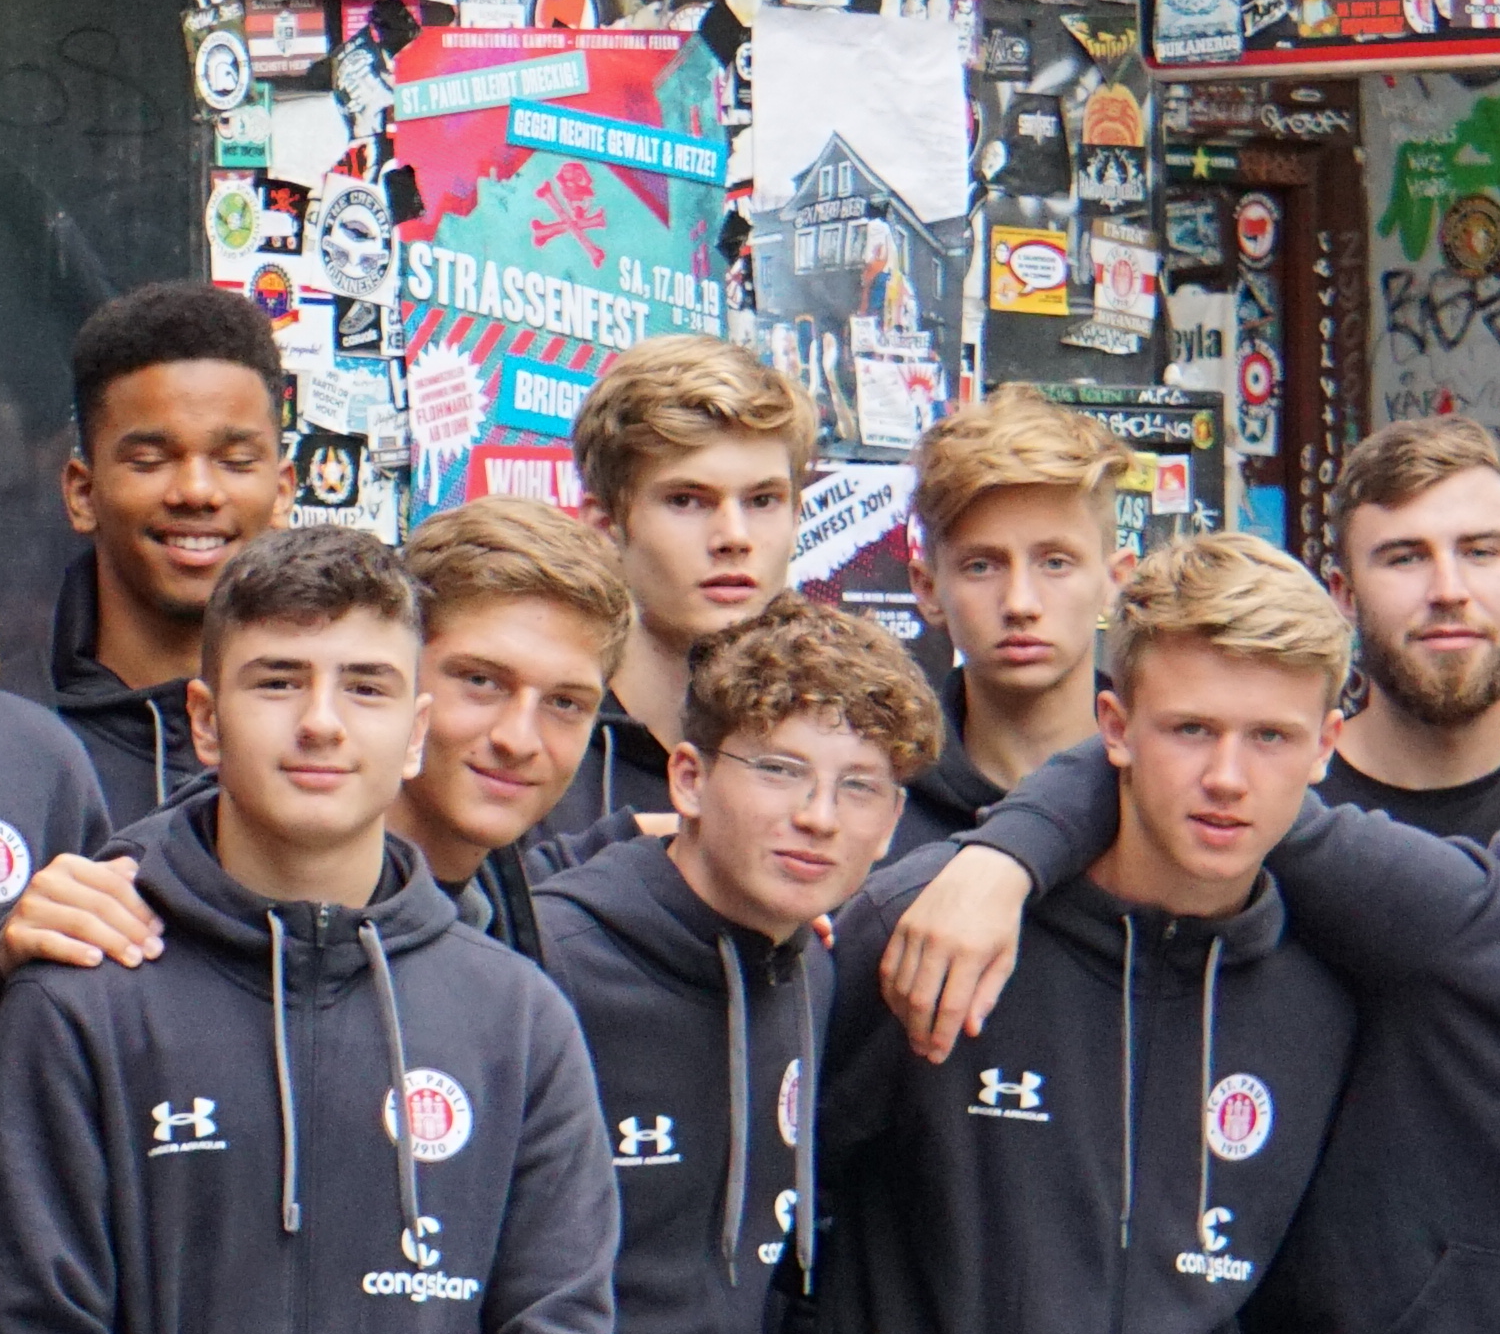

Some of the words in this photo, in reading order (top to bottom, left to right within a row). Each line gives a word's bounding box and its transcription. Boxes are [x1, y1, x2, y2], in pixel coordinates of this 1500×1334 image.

[401, 89, 426, 115] ST.
[430, 82, 468, 111] PAULI
[471, 72, 518, 106] BLEIBT
[521, 60, 582, 96] DRECKIG!
[513, 109, 557, 143] GEGEN
[559, 117, 604, 151] RECHTE
[607, 127, 658, 163] GEWALT
[660, 138, 673, 165] &
[675, 141, 718, 178] HETZE!
[327, 200, 350, 231] THE
[349, 190, 391, 240] CRETAN
[326, 262, 385, 296] GUNNERS
[407, 241, 652, 349] STRASSENFEST
[652, 267, 721, 317] 17.08.19
[362, 1270, 480, 1303] congstar
[1176, 1251, 1253, 1284] congstar
